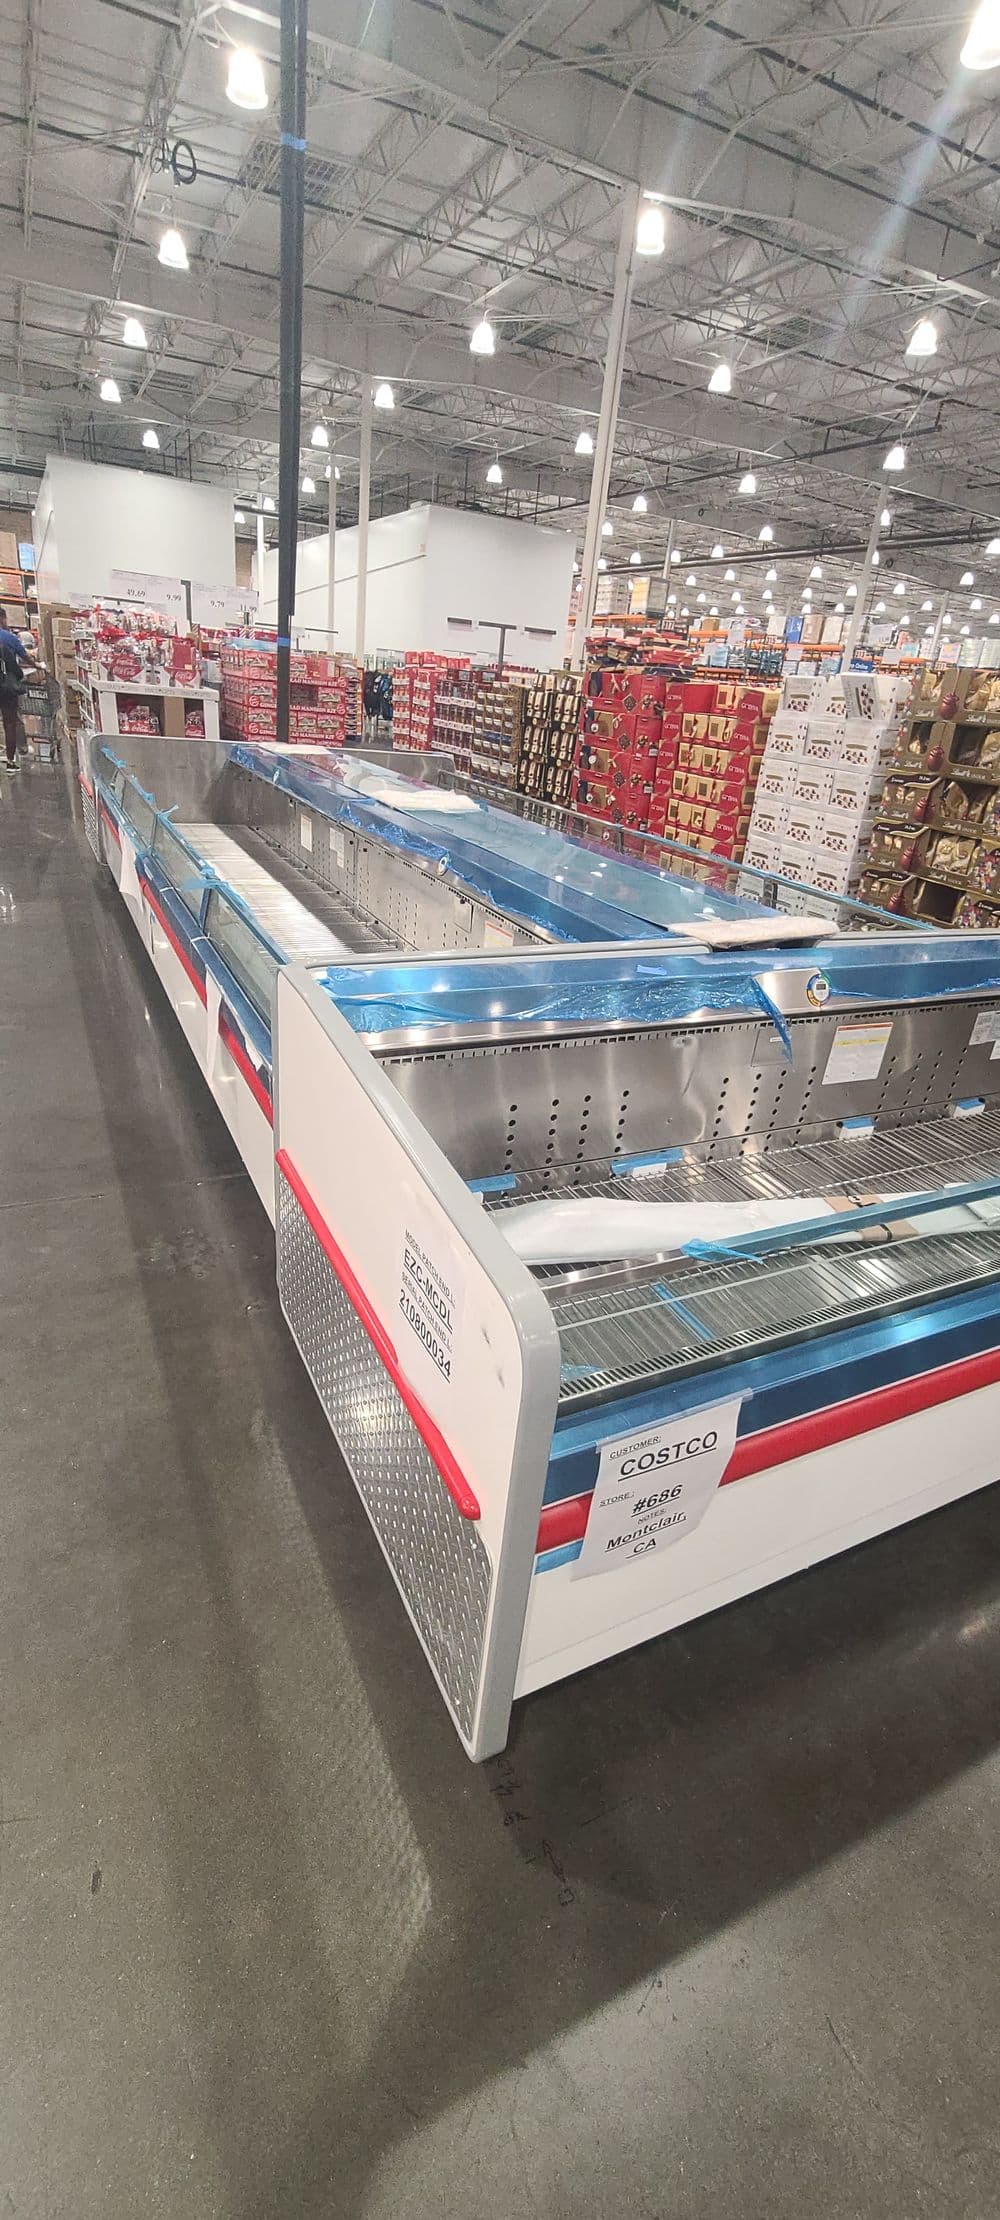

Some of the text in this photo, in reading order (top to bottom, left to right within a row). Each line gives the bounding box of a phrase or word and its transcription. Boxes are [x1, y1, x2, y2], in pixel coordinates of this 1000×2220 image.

[404, 1248, 453, 1331] EZC-MCDL
[400, 1288, 450, 1377] 210800034
[609, 1436, 662, 1459] CUSTOMER:
[620, 1431, 718, 1476] COSTCO
[632, 1484, 683, 1514] #686
[606, 1512, 687, 1549] Montclair,
[633, 1538, 656, 1553] CA
